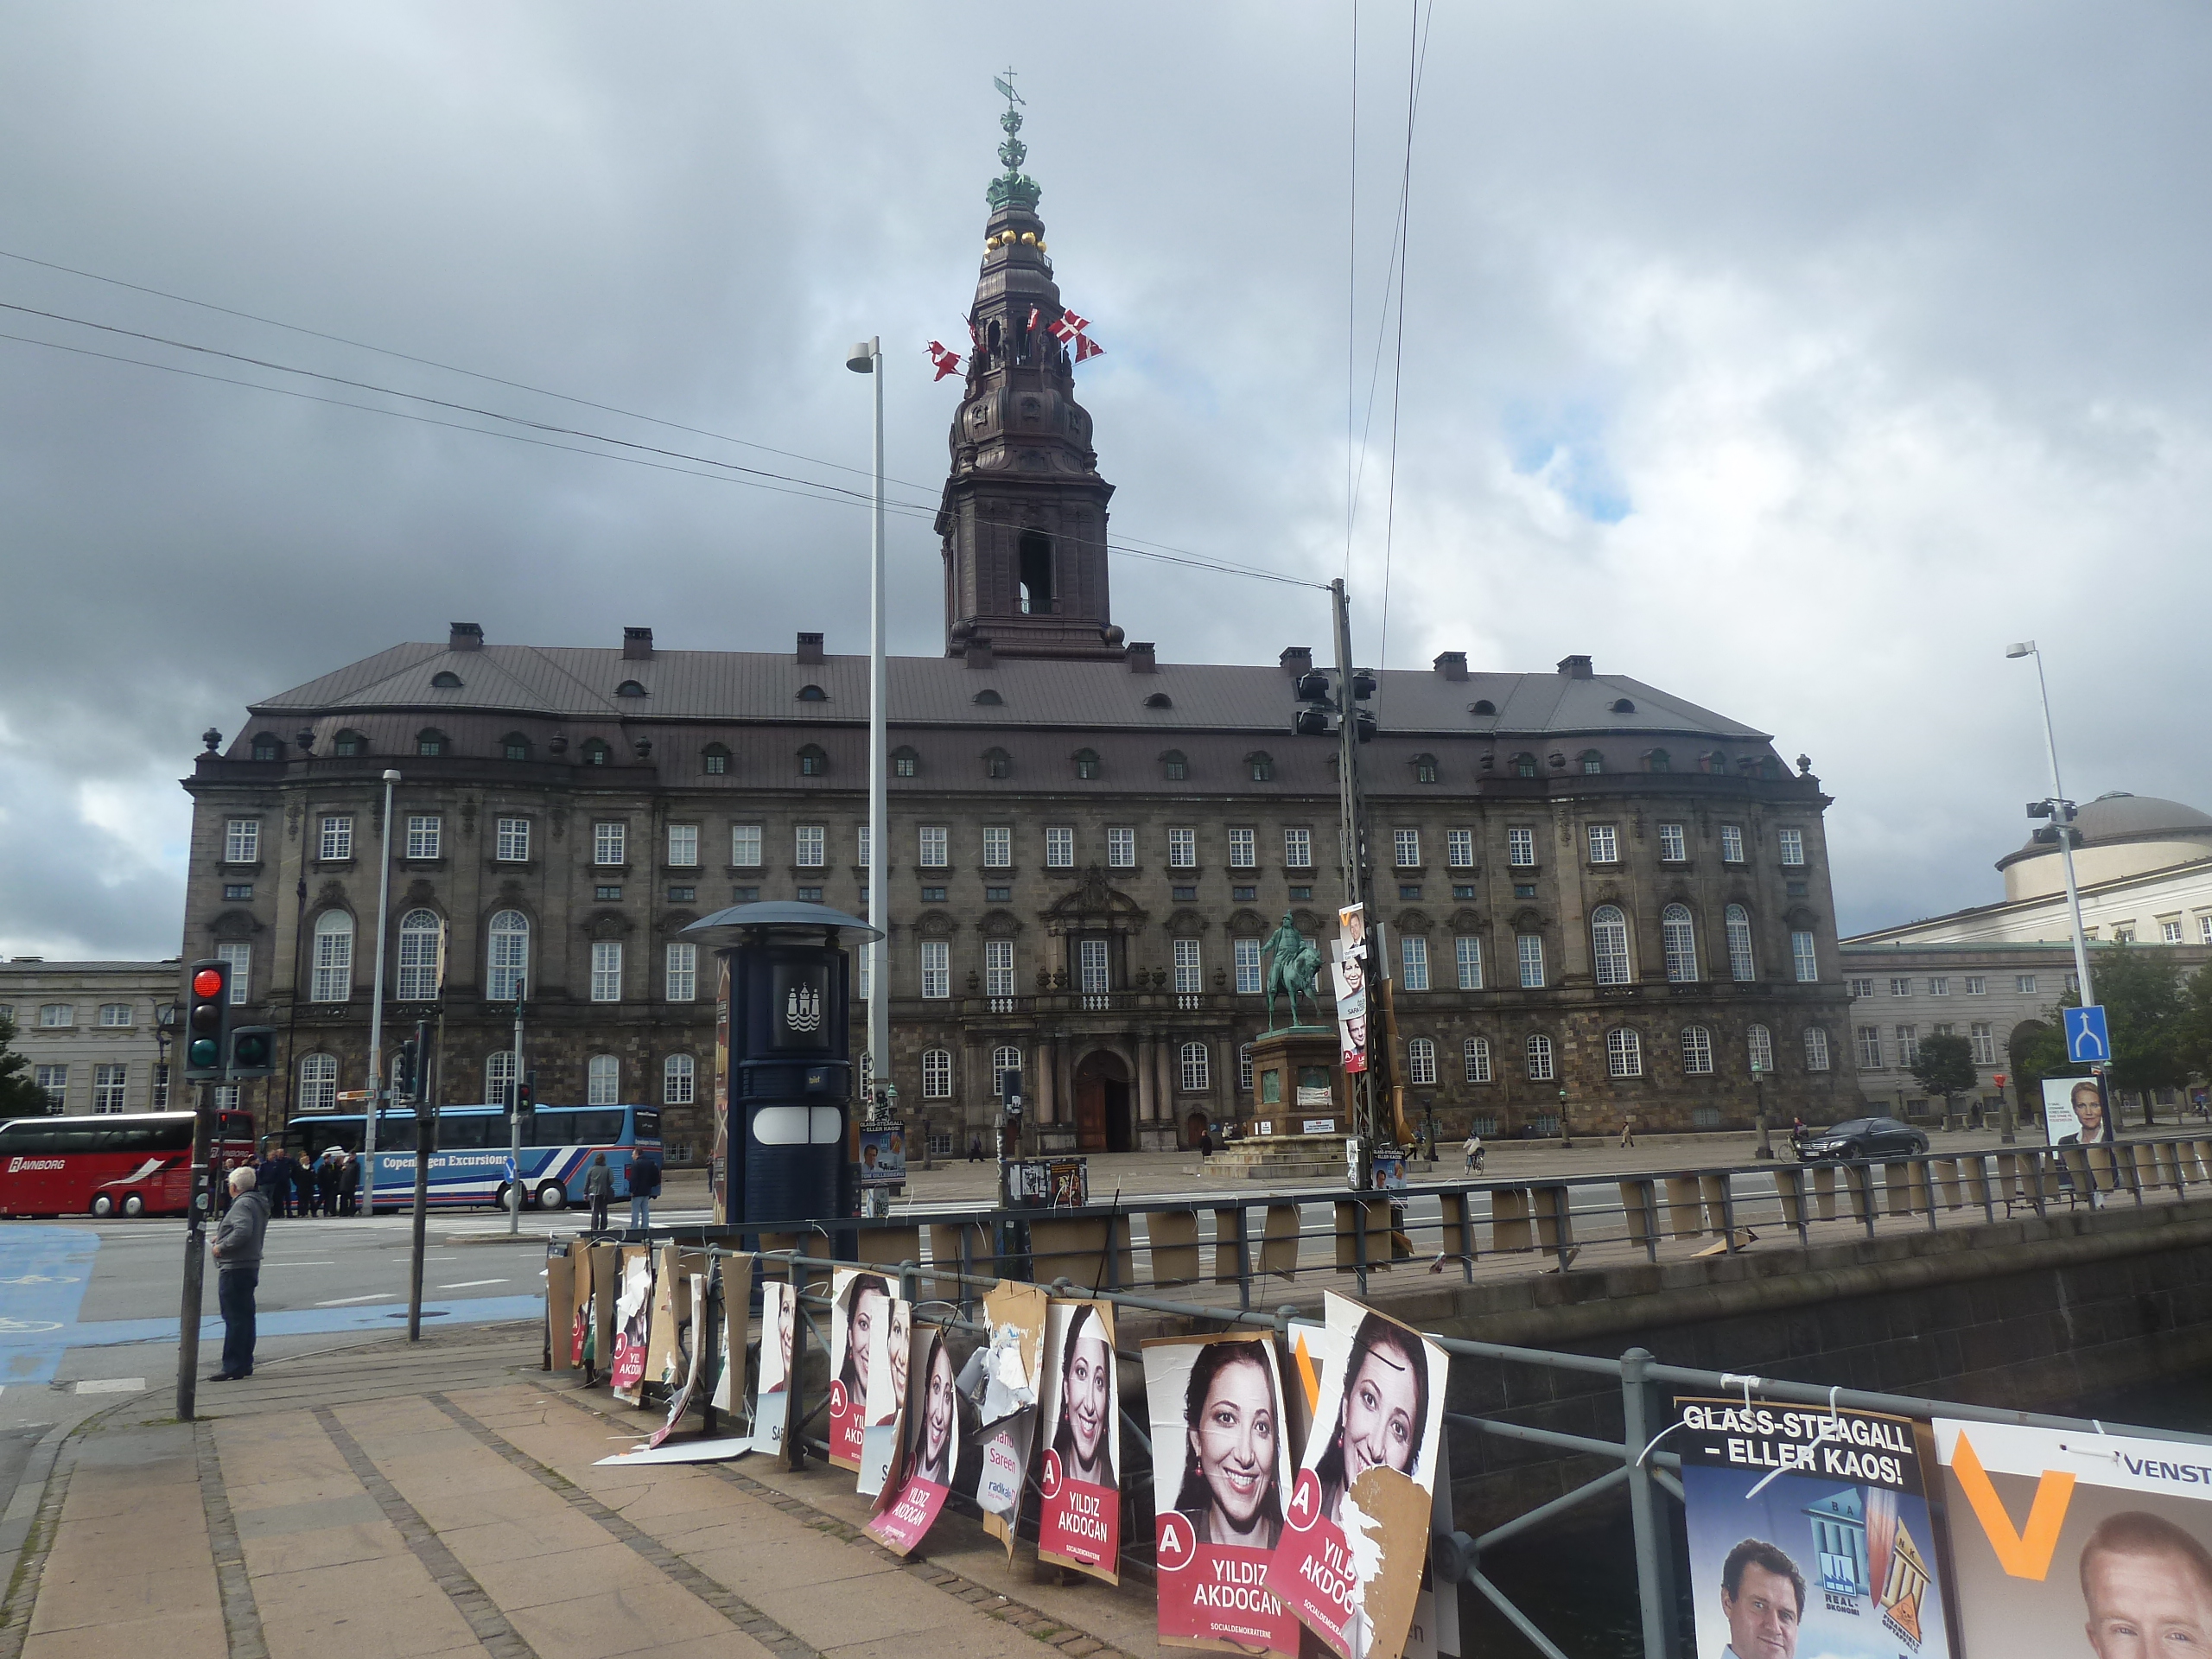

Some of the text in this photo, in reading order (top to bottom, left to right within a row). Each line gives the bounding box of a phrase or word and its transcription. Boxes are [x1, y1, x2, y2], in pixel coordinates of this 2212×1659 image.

[8, 1157, 65, 1173] RAVNBORG
[210, 1147, 250, 1158] RVNBORG
[383, 1154, 508, 1170] Copengen Excursions
[616, 1338, 622, 1351] A
[831, 1388, 842, 1407] A
[1682, 1405, 1913, 1454] GLASS-STEAGALL
[989, 1448, 1016, 1474] Sareen
[1043, 1459, 1055, 1484] A
[1727, 1437, 1817, 1471] ELLER
[1823, 1447, 1904, 1485] KAOS!
[908, 1486, 931, 1508] YILDIZ
[1070, 1491, 1100, 1517] YILDIZ
[1292, 1481, 1311, 1516] A
[1950, 1427, 2076, 1582] V
[1058, 1510, 1107, 1542] AKDOGAN
[1159, 1524, 1182, 1553] A
[1211, 1559, 1268, 1586] YILDIZ
[1193, 1583, 1281, 1617] AKDOGAN
[1211, 1623, 1272, 1640] SOCIALDEMOKRATERNE
